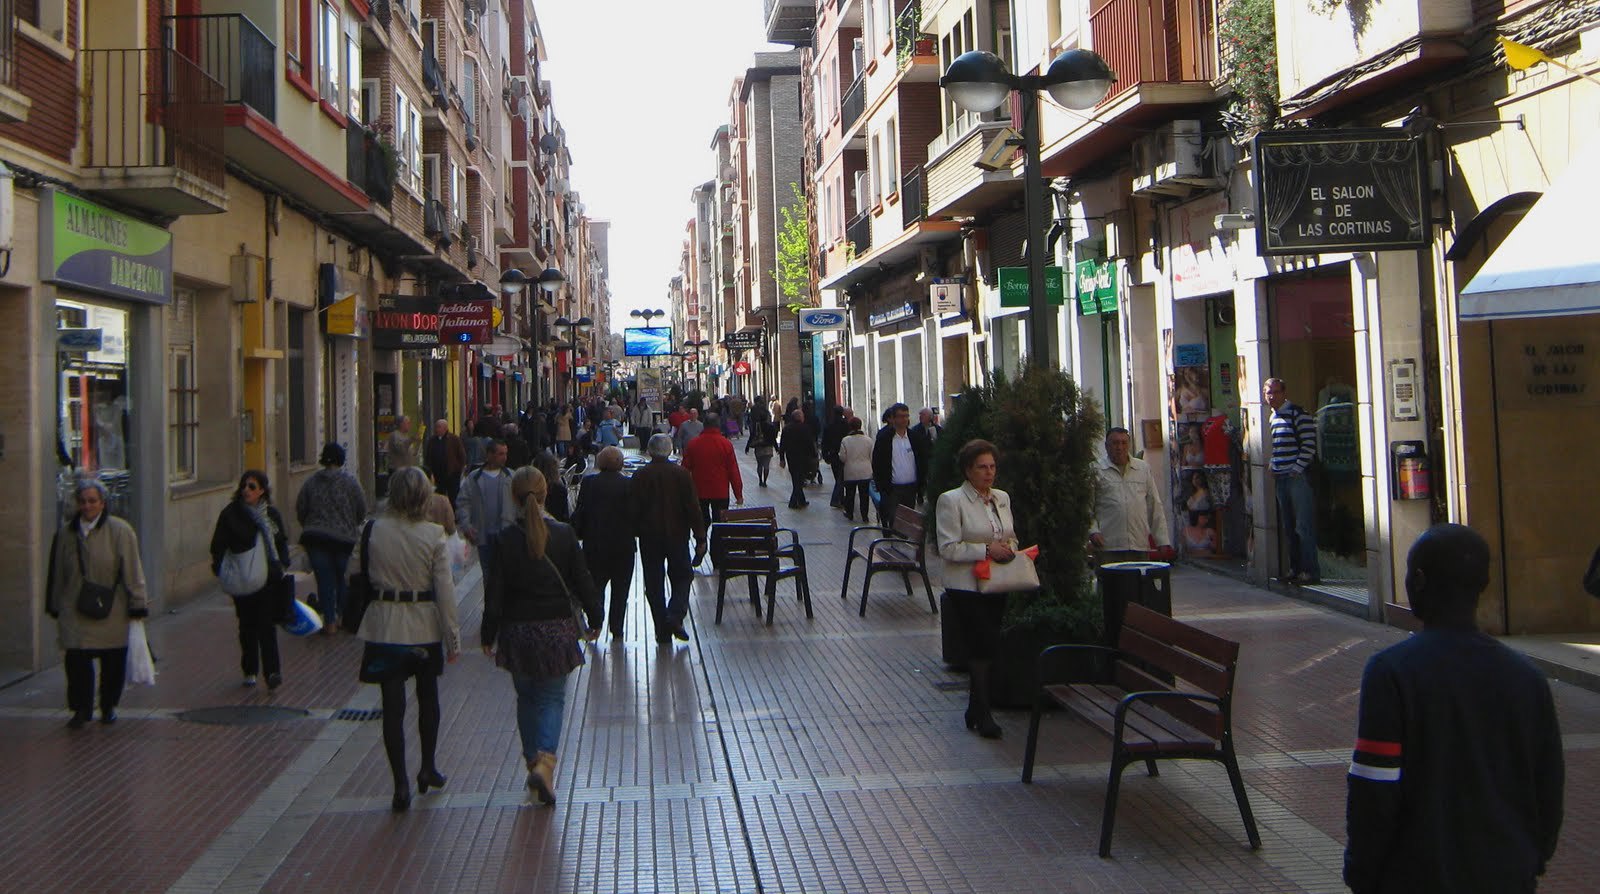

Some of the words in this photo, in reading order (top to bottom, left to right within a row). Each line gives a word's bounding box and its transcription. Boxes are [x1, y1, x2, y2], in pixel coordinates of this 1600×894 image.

[1311, 187, 1326, 200] EL
[1332, 185, 1374, 200] SALON
[1335, 204, 1352, 217] DE
[66, 201, 128, 249] ALMACENES
[1298, 223, 1323, 237] LAS
[1329, 220, 1392, 235] CORTINAS
[111, 255, 164, 296] BARCELONA
[439, 302, 484, 313] helados
[440, 314, 489, 330] Italianos
[812, 314, 837, 325] Ford
